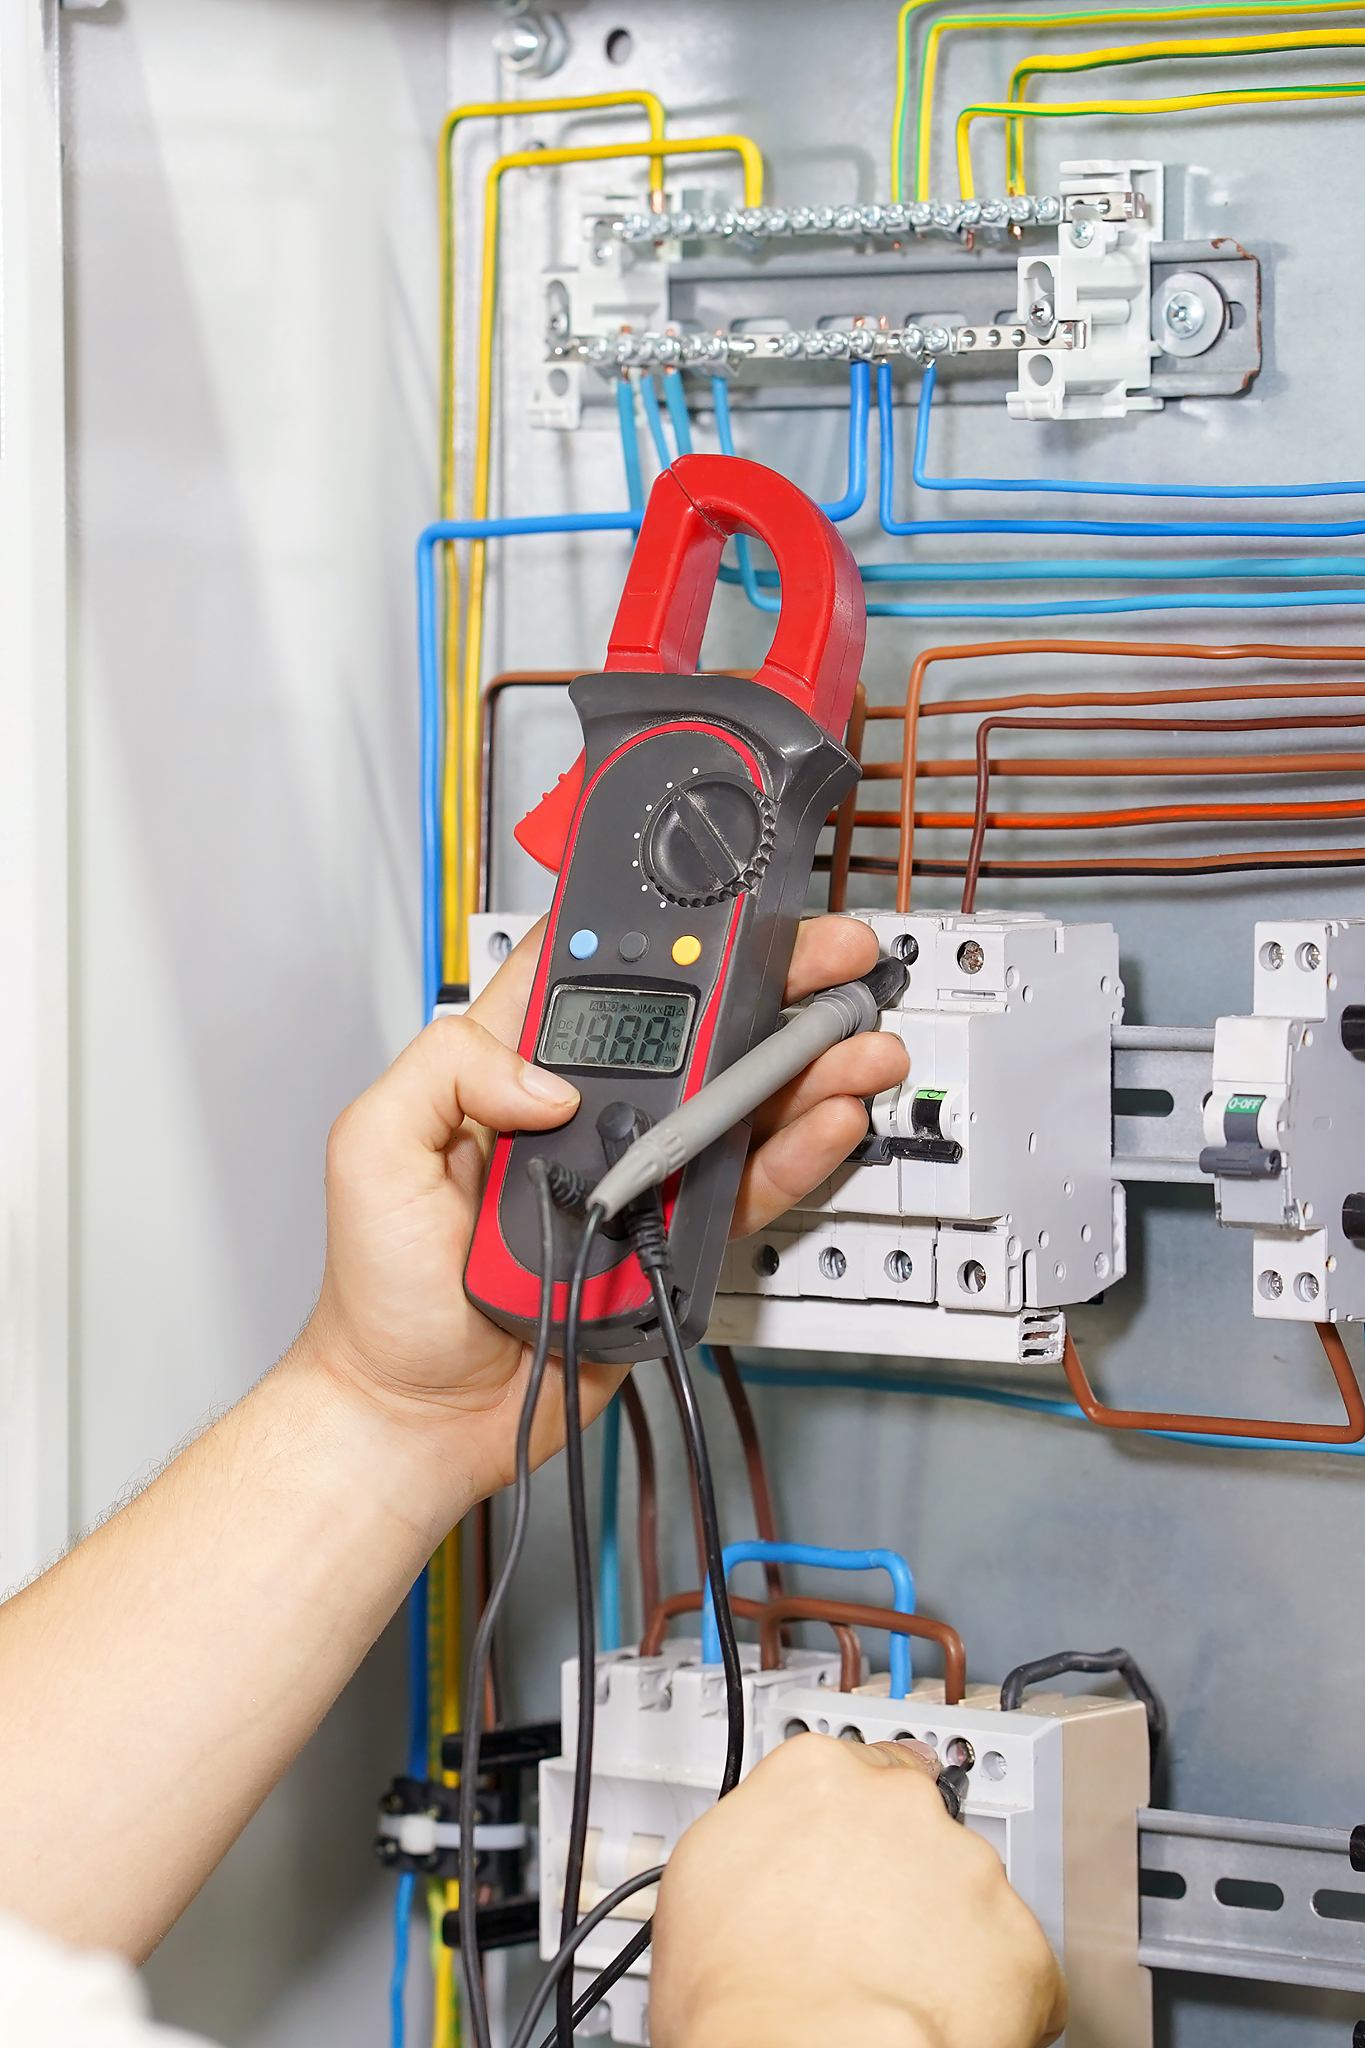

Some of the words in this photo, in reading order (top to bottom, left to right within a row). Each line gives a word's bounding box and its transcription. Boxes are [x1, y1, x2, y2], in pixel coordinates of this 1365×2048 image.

[590, 1001, 618, 1012] AUTO
[642, 1004, 663, 1014] MAX
[558, 1020, 574, 1029] DC
[553, 1040, 569, 1050] AC
